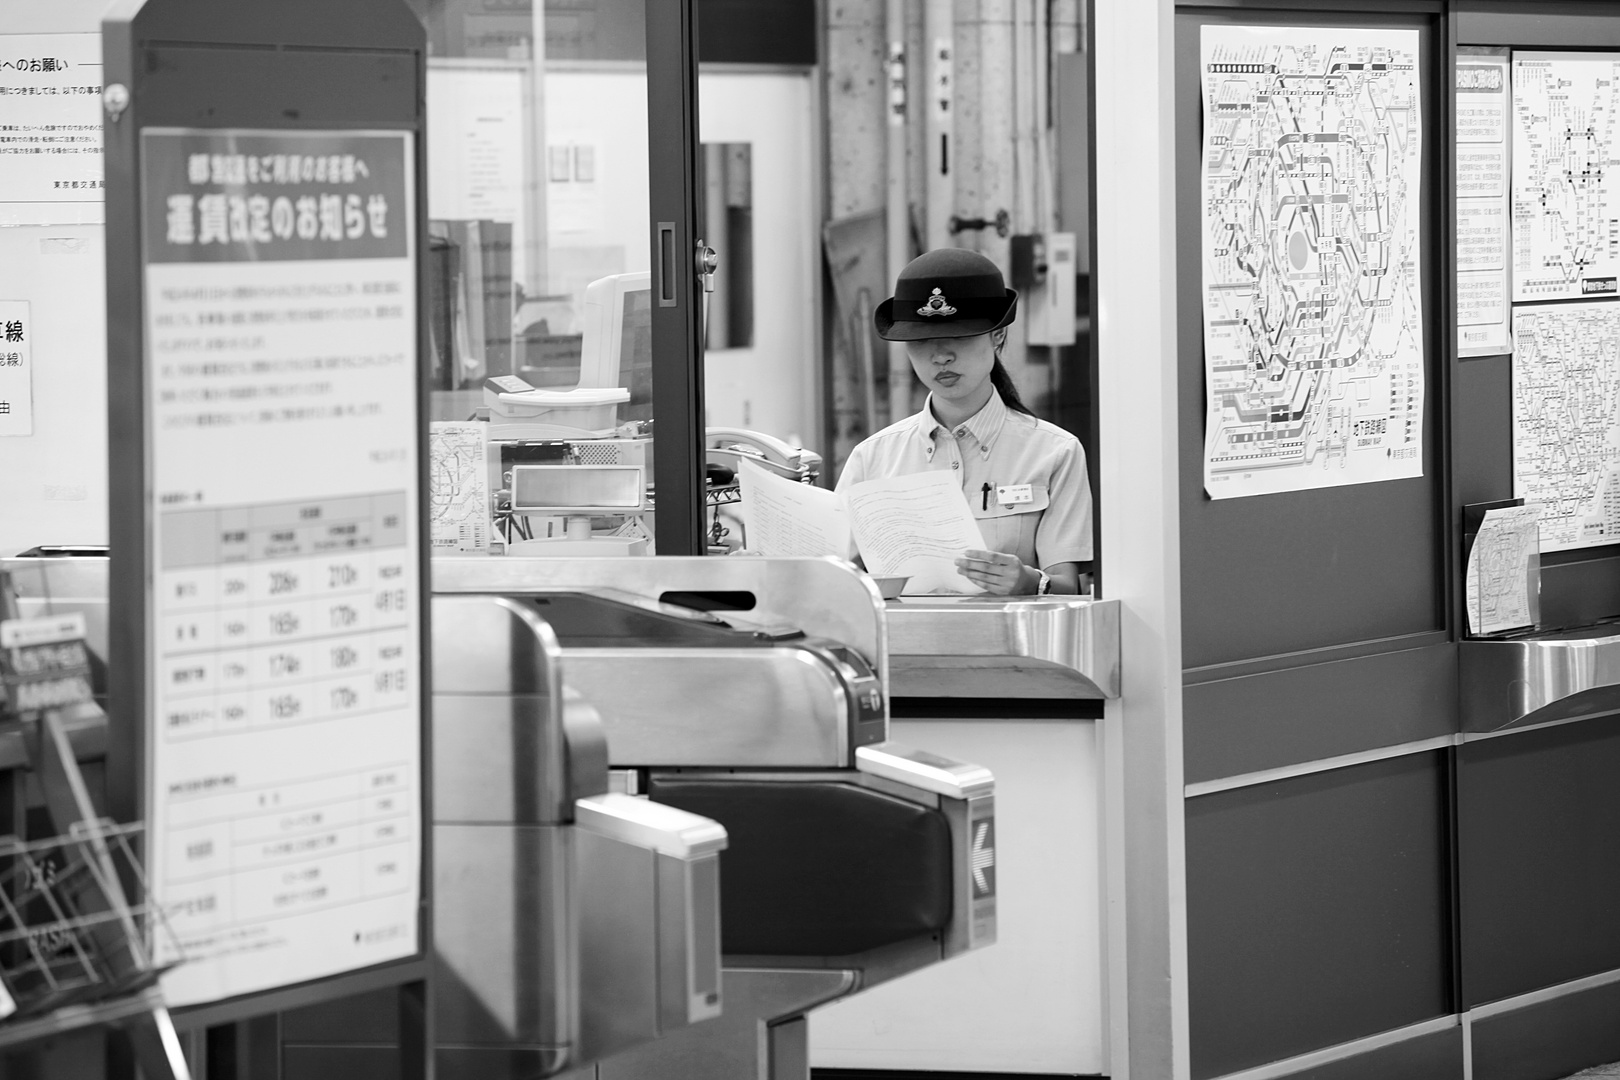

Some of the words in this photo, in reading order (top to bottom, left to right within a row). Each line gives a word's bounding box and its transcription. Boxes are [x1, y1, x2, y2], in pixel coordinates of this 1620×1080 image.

[0, 58, 69, 72] へのお願い
[166, 193, 388, 244] 運賃改定のお知らせ
[0, 320, 24, 343] 線
